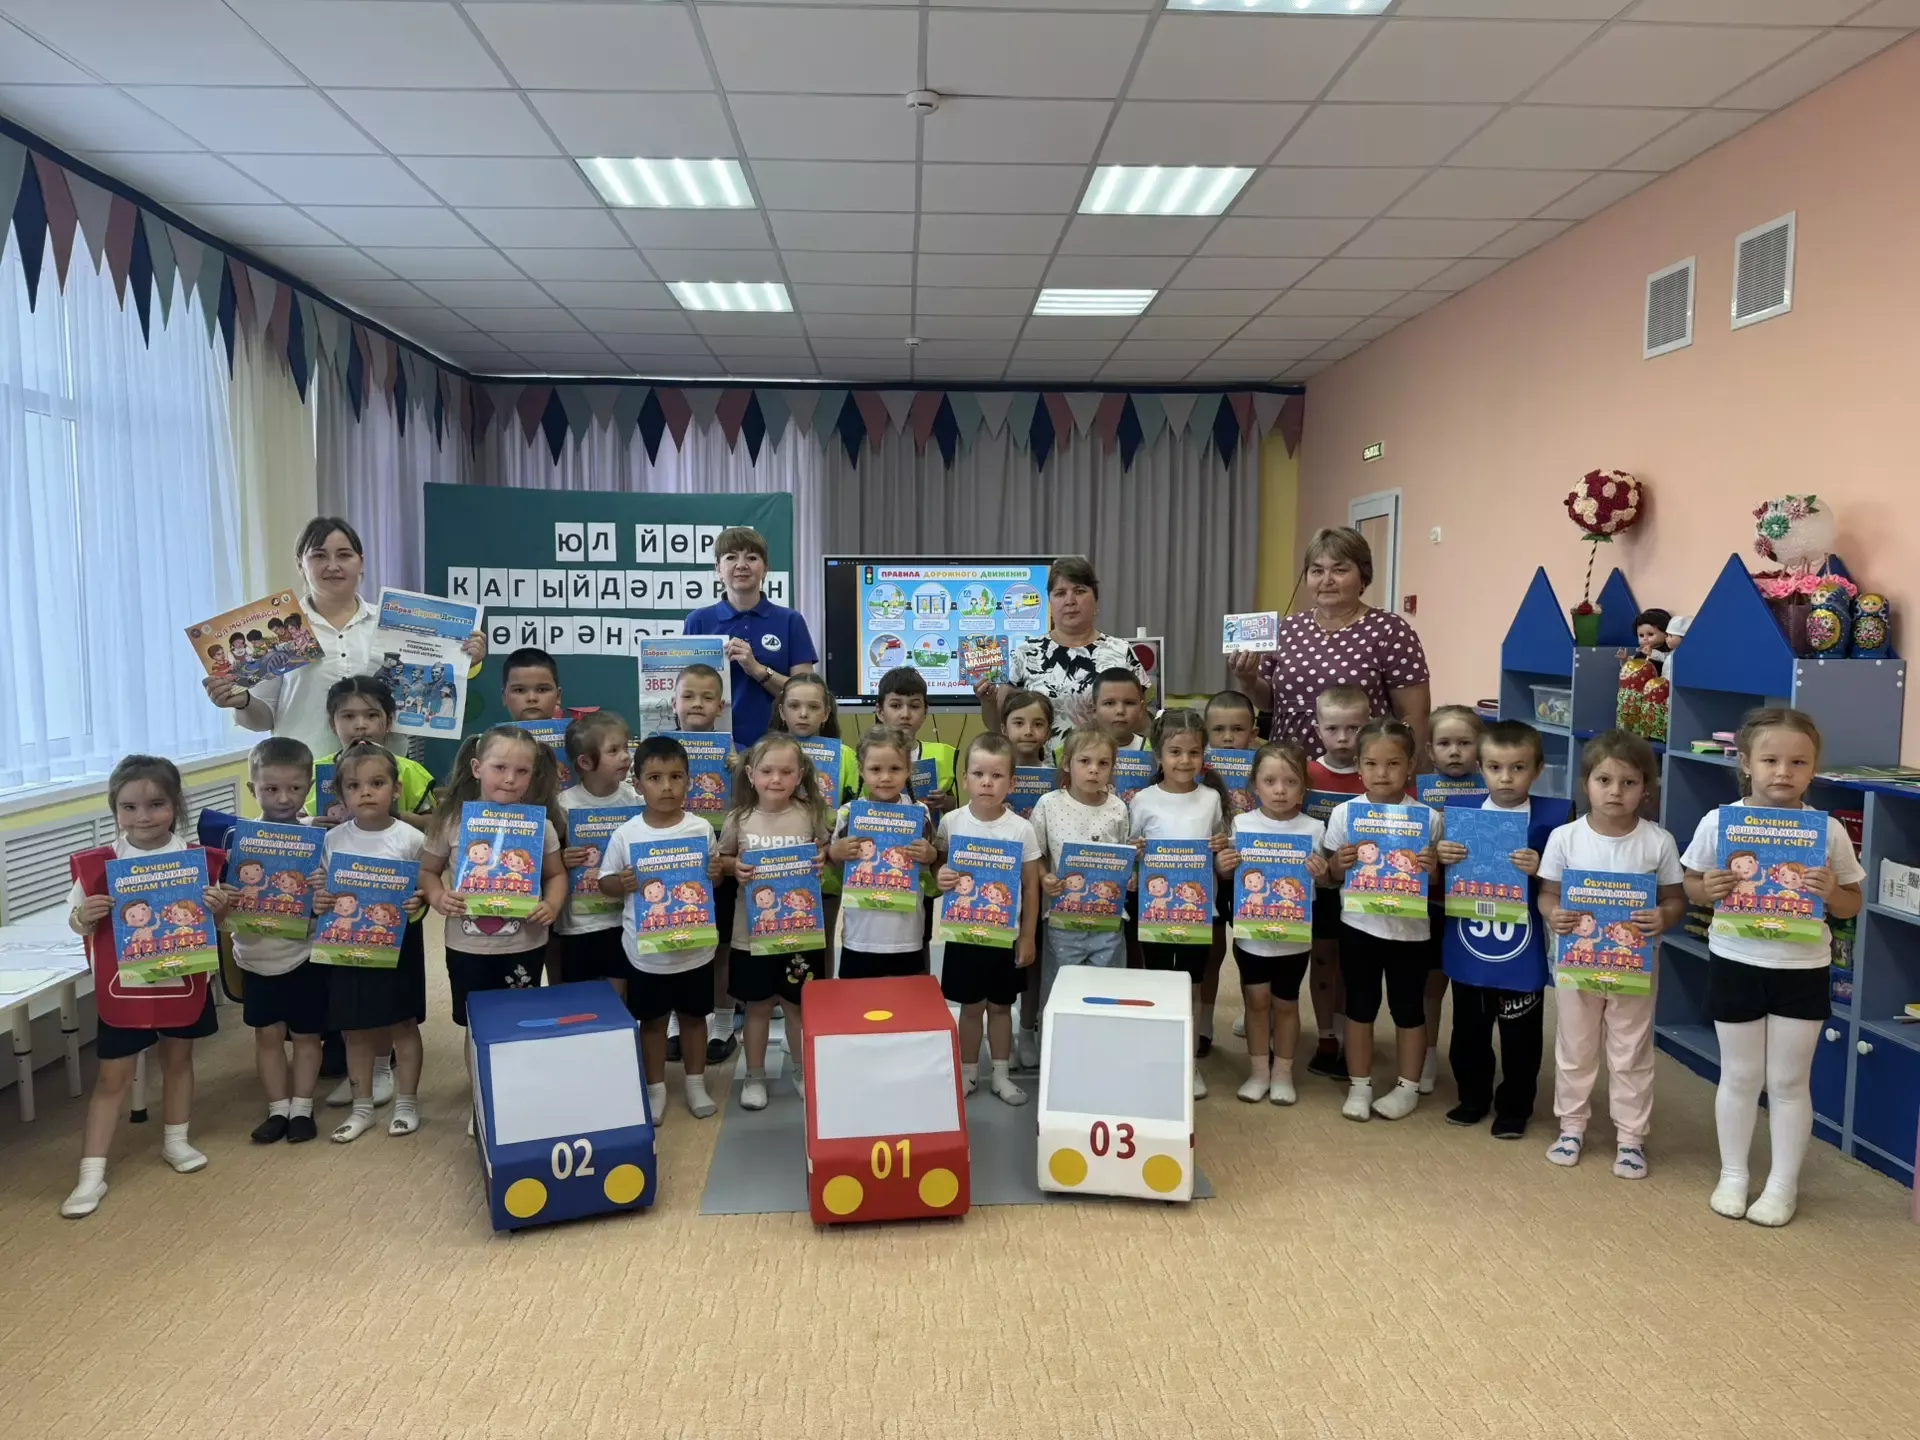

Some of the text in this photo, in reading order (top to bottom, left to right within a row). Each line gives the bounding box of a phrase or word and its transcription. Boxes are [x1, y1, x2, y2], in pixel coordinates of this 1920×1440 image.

[558, 529, 714, 553] ЮЛ ЙӨР
[923, 571, 977, 579] ДОРОЖНОГО
[453, 569, 783, 602] КАГЫЙДӘЛӘРН
[384, 603, 412, 613] Добрая
[441, 612, 473, 625] Детства
[215, 629, 229, 640] ЮЛ
[694, 648, 721, 656] Детства
[965, 654, 1004, 668] МАШИНЫ
[645, 678, 674, 691] ЗВЕЗ
[1211, 755, 1246, 764] ОБУЧЕНИЕ
[1436, 780, 1476, 788] ОБУЧЕНИЕ
[482, 809, 525, 820] ОБУЧЕНИЕ
[868, 808, 904, 819] ОБУЧЕНИЕ
[1368, 810, 1408, 821] ОБУЧЕНИЕ
[467, 817, 538, 830] ДОШКОЛЬНИКОВ
[854, 816, 917, 829] ДОШКОЛЬНИКОВ
[1353, 817, 1422, 830] ДОШКОЛЬНИКОВ
[1744, 816, 1799, 828] ОБУЧЕНИЕ
[467, 826, 501, 834] ЧИСЛАМ
[512, 828, 536, 836] СЧЁТУ
[855, 824, 885, 832] ЧИСЛАМ
[893, 826, 915, 835] СЧЁТУ
[1354, 826, 1388, 835] ЧИСЛАМ
[1397, 829, 1421, 837] СЧЁТУ
[1726, 825, 1818, 839] ДОШКОЛЬНИКОВ
[257, 830, 302, 842] ОБУЧЕНИЕ
[747, 834, 805, 849] Puppy
[1728, 833, 1770, 844] ЧИСЛАМ
[1784, 838, 1815, 847] СЧЁТУ
[240, 836, 316, 851] ДОШКОЛЬНИКОВ
[967, 843, 1004, 855] ОБУЧЕНИЕ
[1253, 839, 1293, 849] ОБУЧЕНИЕ
[240, 845, 277, 856] ЧИСЛАМ
[287, 849, 314, 858] СЧЁТУ
[649, 847, 689, 856] ОБУЧЕНИЕ
[1080, 850, 1117, 858] ОБУЧЕНИЕ
[1157, 846, 1194, 854] ОБУЧЕНИЕ
[1240, 847, 1306, 859] ДОШКОЛЬНИКОВ
[637, 852, 704, 869] ДОШКОЛЬНИКОВ
[760, 855, 798, 865] ОБУЧЕНИЕ
[953, 850, 1016, 864] ДОШКОЛЬНИКОВ
[1066, 855, 1127, 866] ДОШКОЛЬНИКОВ
[1144, 854, 1207, 862] ДОШКОЛЬНИКОВ
[1241, 855, 1273, 863] ЧИСЛАМ
[1281, 857, 1305, 865] СЧЁТУ
[131, 861, 182, 875] ОБУЧЕНИЕ
[352, 862, 396, 875] ОБУЧЕНИЕ
[638, 863, 671, 873] ЧИСЛАМ
[681, 860, 702, 868] СЧЁТУ
[754, 860, 812, 873] ОШКОЛЬНИКОВ
[954, 859, 984, 868] ЧИСЛАМ
[992, 862, 1014, 871] СЧЁТУ
[1145, 861, 1175, 869] ЧИСЛАМ
[1184, 861, 1205, 869] СЧЁТУ
[115, 866, 199, 888] ДОШКОЛЬНИКОВ
[335, 869, 409, 884] ДОШКОЛЬНИКОВ
[790, 868, 812, 877] СЧЁТУ
[116, 882, 158, 894] ЧИСЛАМ
[170, 876, 198, 886] СЧЁТУ
[335, 877, 370, 888] ЧИСЛАМ
[381, 882, 406, 891] СЧЁТУ
[1584, 878, 1632, 890] ОБУЧЕНИЕ
[1567, 886, 1647, 900] ДОШКОЛЬНИКОВ
[1569, 896, 1606, 905] ЧИСЛАМ
[1618, 899, 1645, 908] СЧЁТУ
[1089, 1121, 1136, 1159] 03
[551, 1138, 595, 1180] 02
[871, 1139, 911, 1179] 01
